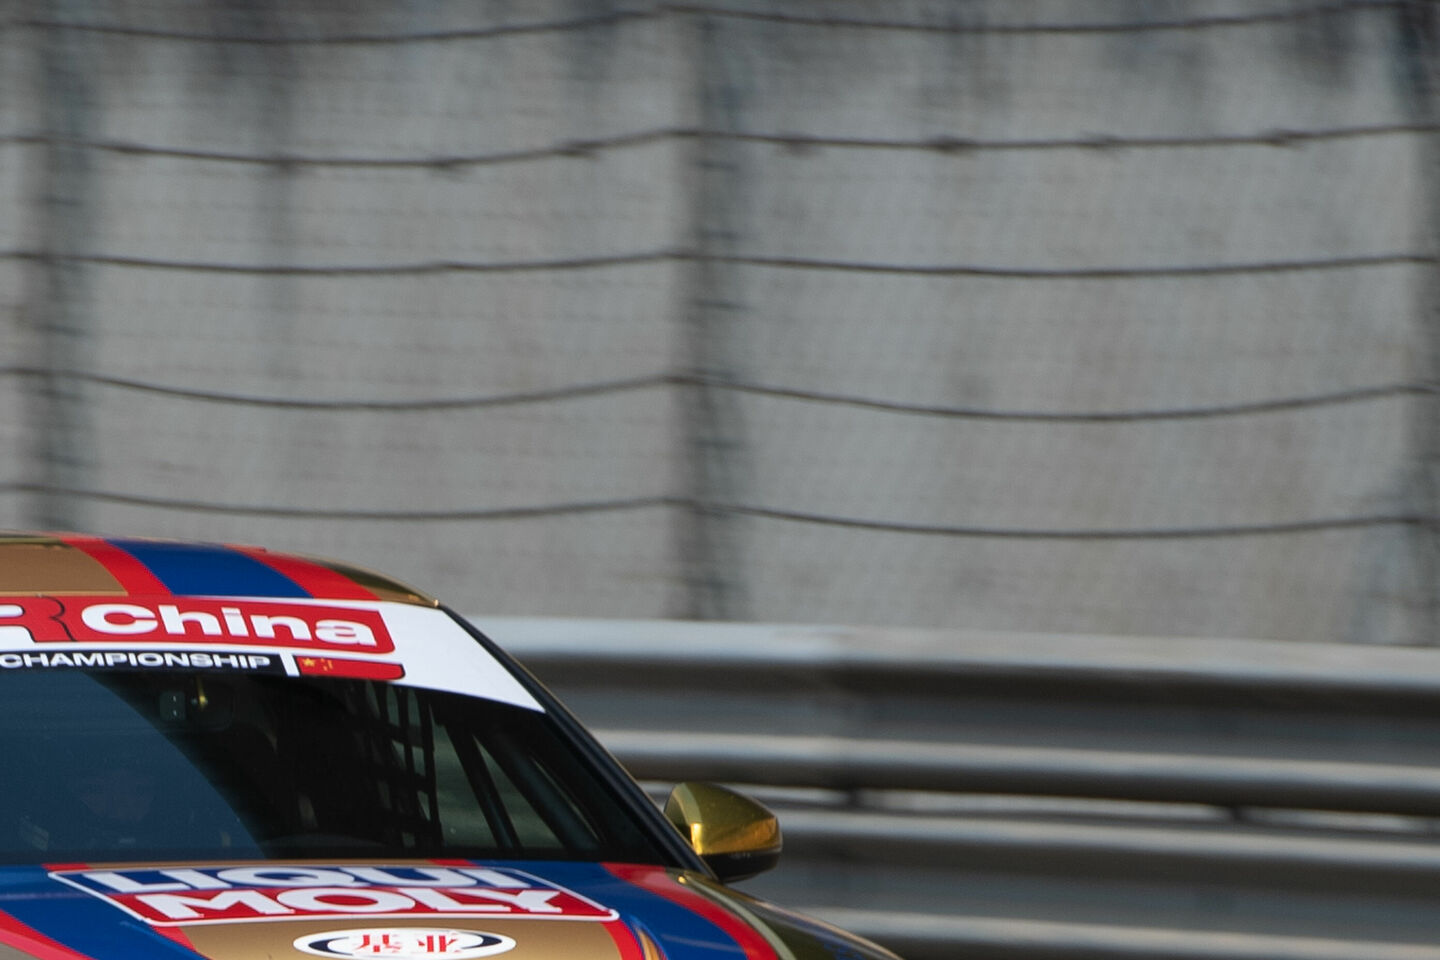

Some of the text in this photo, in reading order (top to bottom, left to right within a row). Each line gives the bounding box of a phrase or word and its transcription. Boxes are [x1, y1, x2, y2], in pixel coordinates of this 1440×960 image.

[81, 604, 377, 646] China
[78, 866, 532, 891] LIQUI
[134, 887, 563, 918] MOLY
